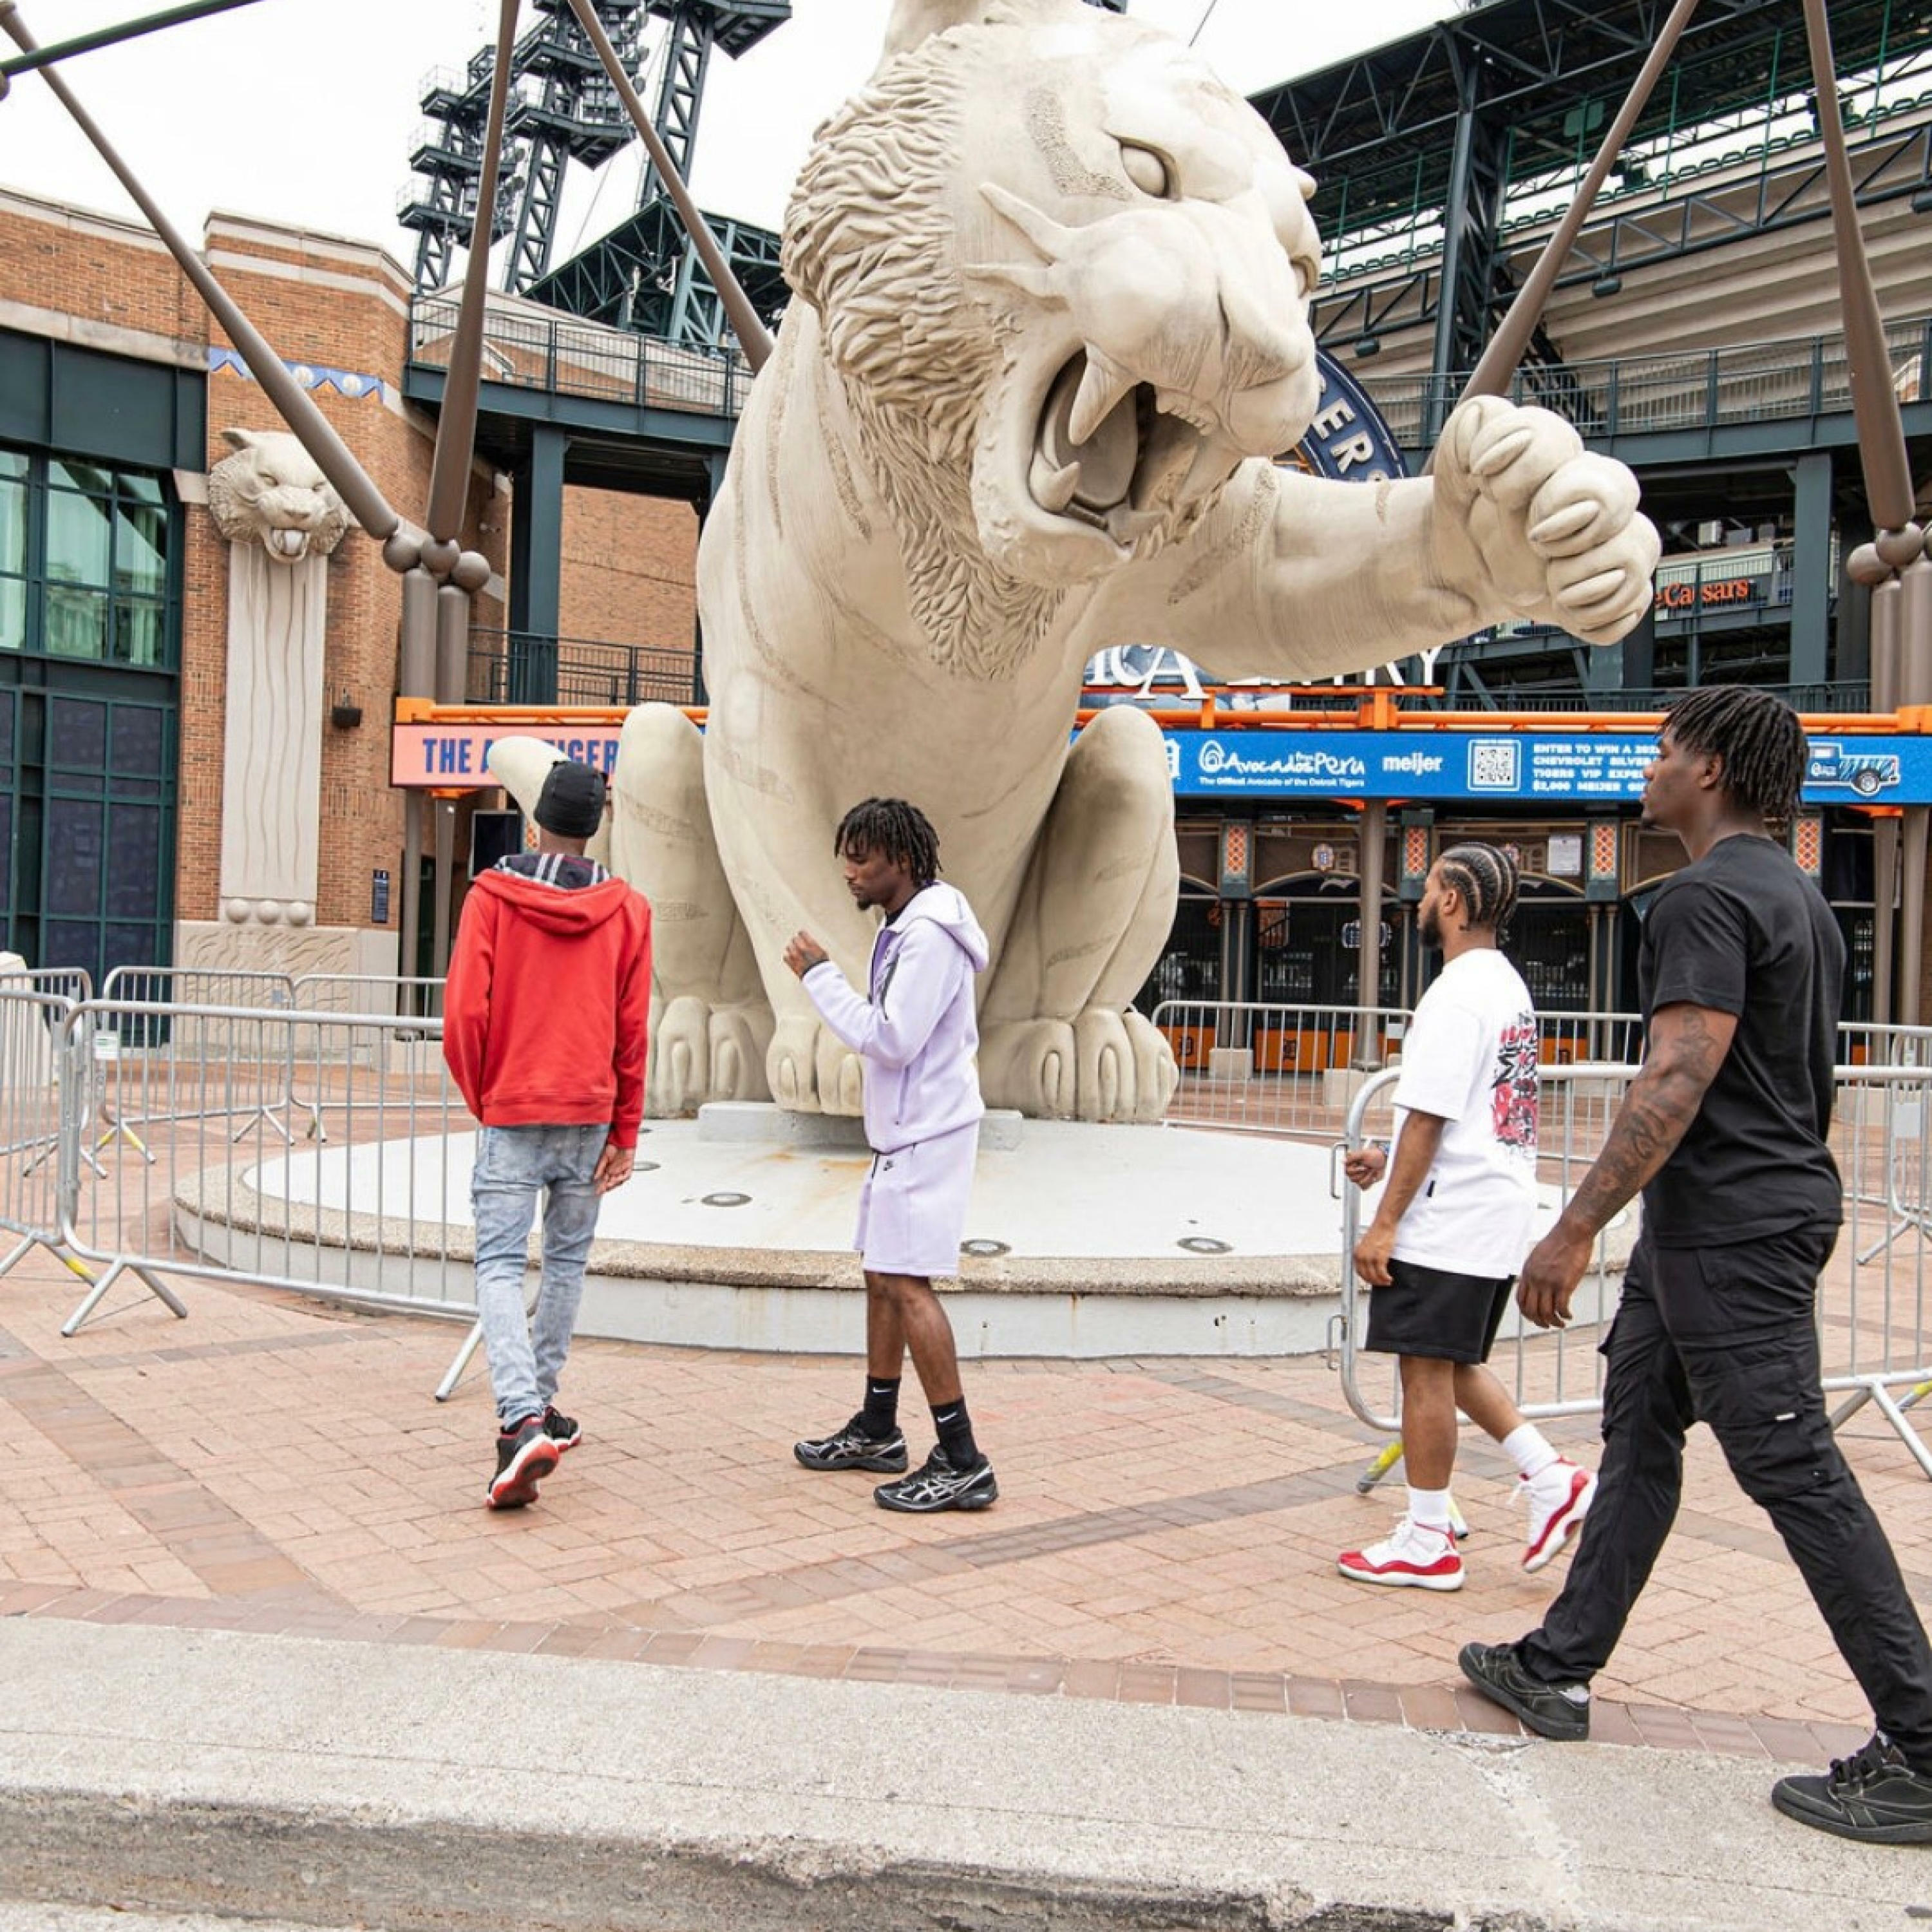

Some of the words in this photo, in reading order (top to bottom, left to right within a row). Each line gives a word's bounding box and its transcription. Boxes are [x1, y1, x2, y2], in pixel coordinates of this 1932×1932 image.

[1663, 579, 1748, 607] Casars
[422, 739, 473, 773] THE
[1533, 743, 1572, 753] ENTER
[1575, 744, 1591, 753] TO
[1594, 744, 1619, 753] WIN
[1623, 744, 1632, 753] A
[1382, 752, 1443, 777] meijer
[1533, 756, 1602, 766] CHEVROLET
[1533, 768, 1575, 778] TIGERS
[1582, 769, 1602, 779] VIP
